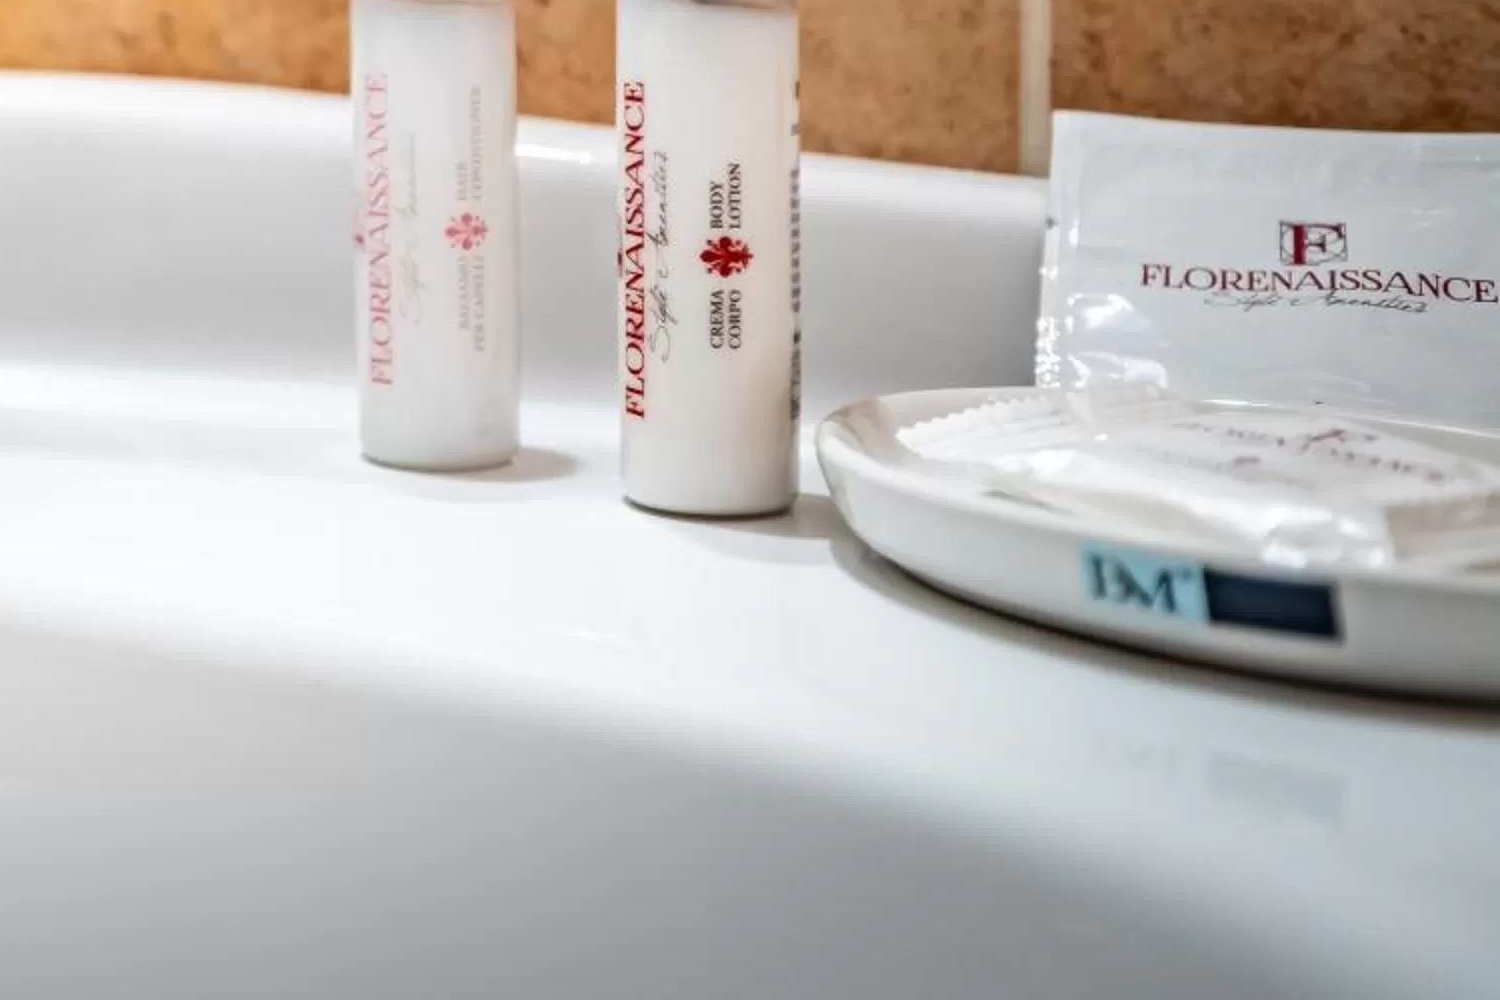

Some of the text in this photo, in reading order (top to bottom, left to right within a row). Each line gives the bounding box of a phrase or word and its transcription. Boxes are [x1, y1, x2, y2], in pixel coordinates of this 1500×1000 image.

[710, 180, 724, 229] BODY
[727, 163, 742, 229] LOTION
[622, 81, 646, 420] FLORENAISSANCE
[1140, 263, 1499, 304] FLORENAISSANCE
[710, 289, 724, 350] CREMA
[727, 290, 742, 350] CORPO
